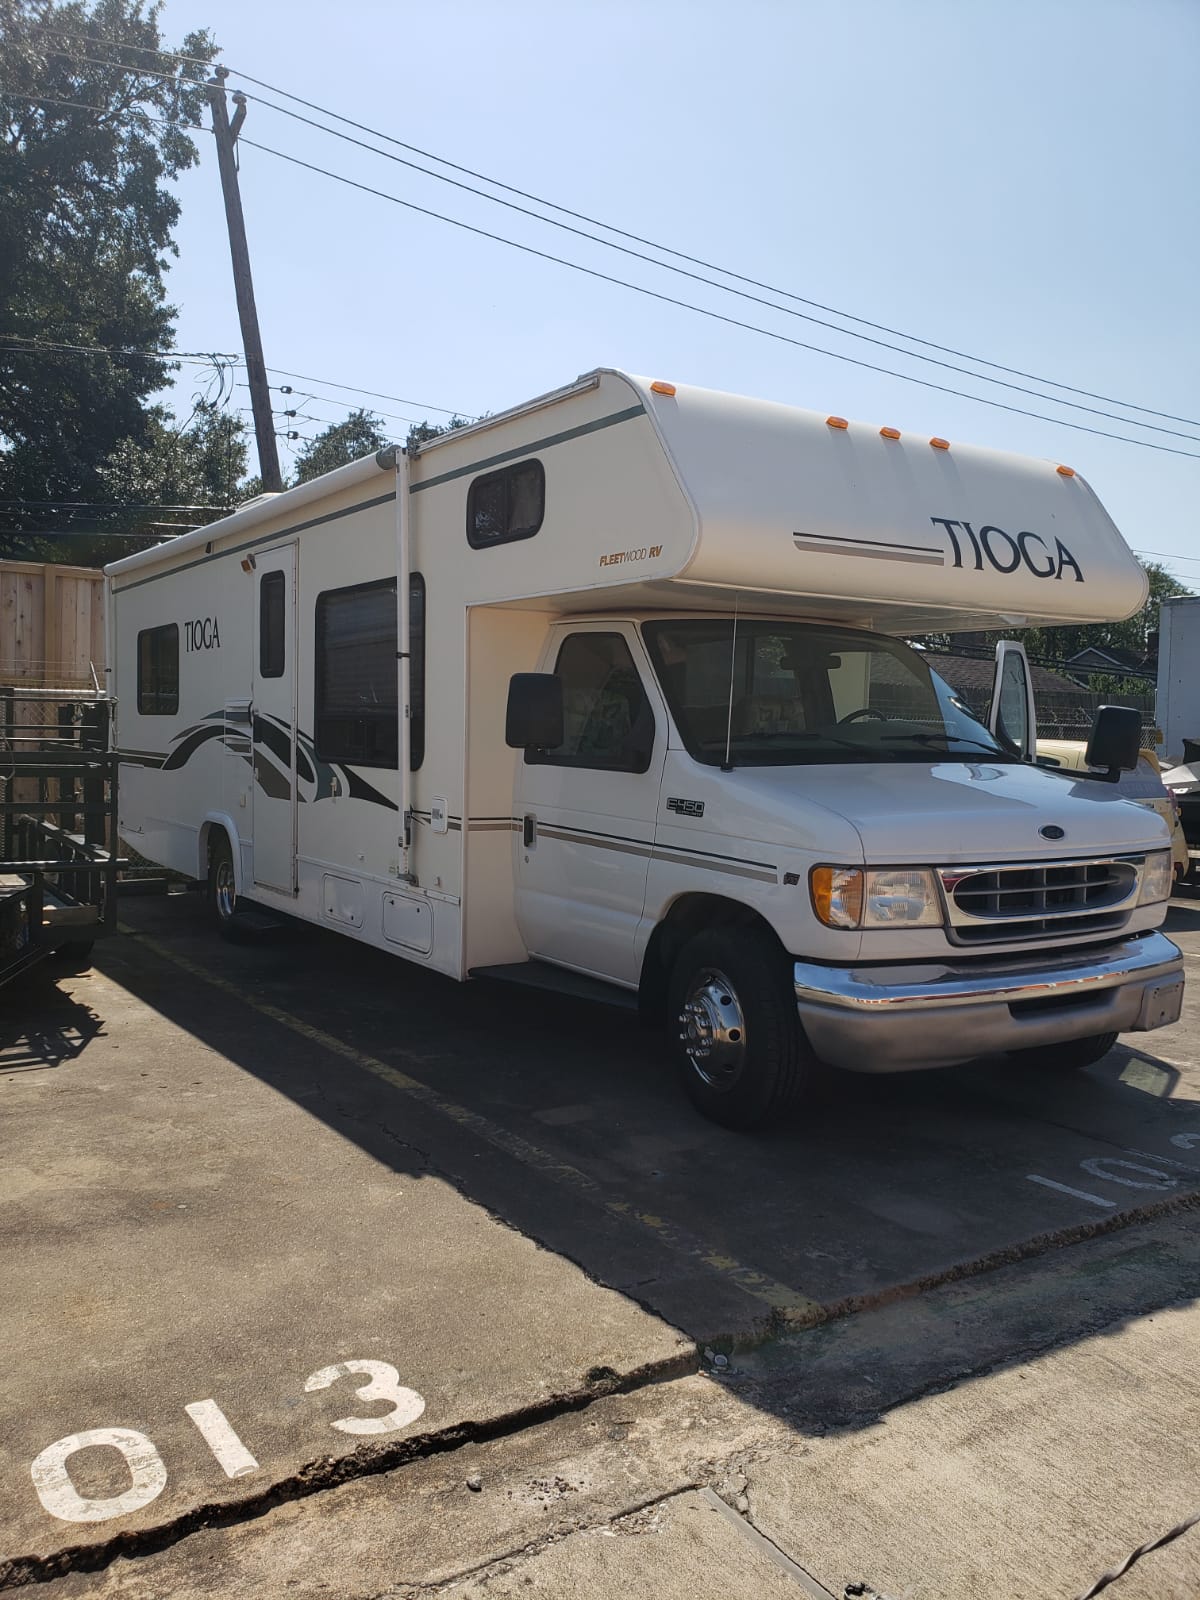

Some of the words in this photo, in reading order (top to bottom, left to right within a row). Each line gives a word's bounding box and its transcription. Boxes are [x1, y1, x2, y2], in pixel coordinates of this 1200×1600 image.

[599, 549, 646, 567] FLEETWOOD
[648, 545, 663, 559] RV
[930, 517, 1084, 582] TIOGA
[184, 616, 221, 652] TIOGA
[30, 1359, 426, 1522] 013
